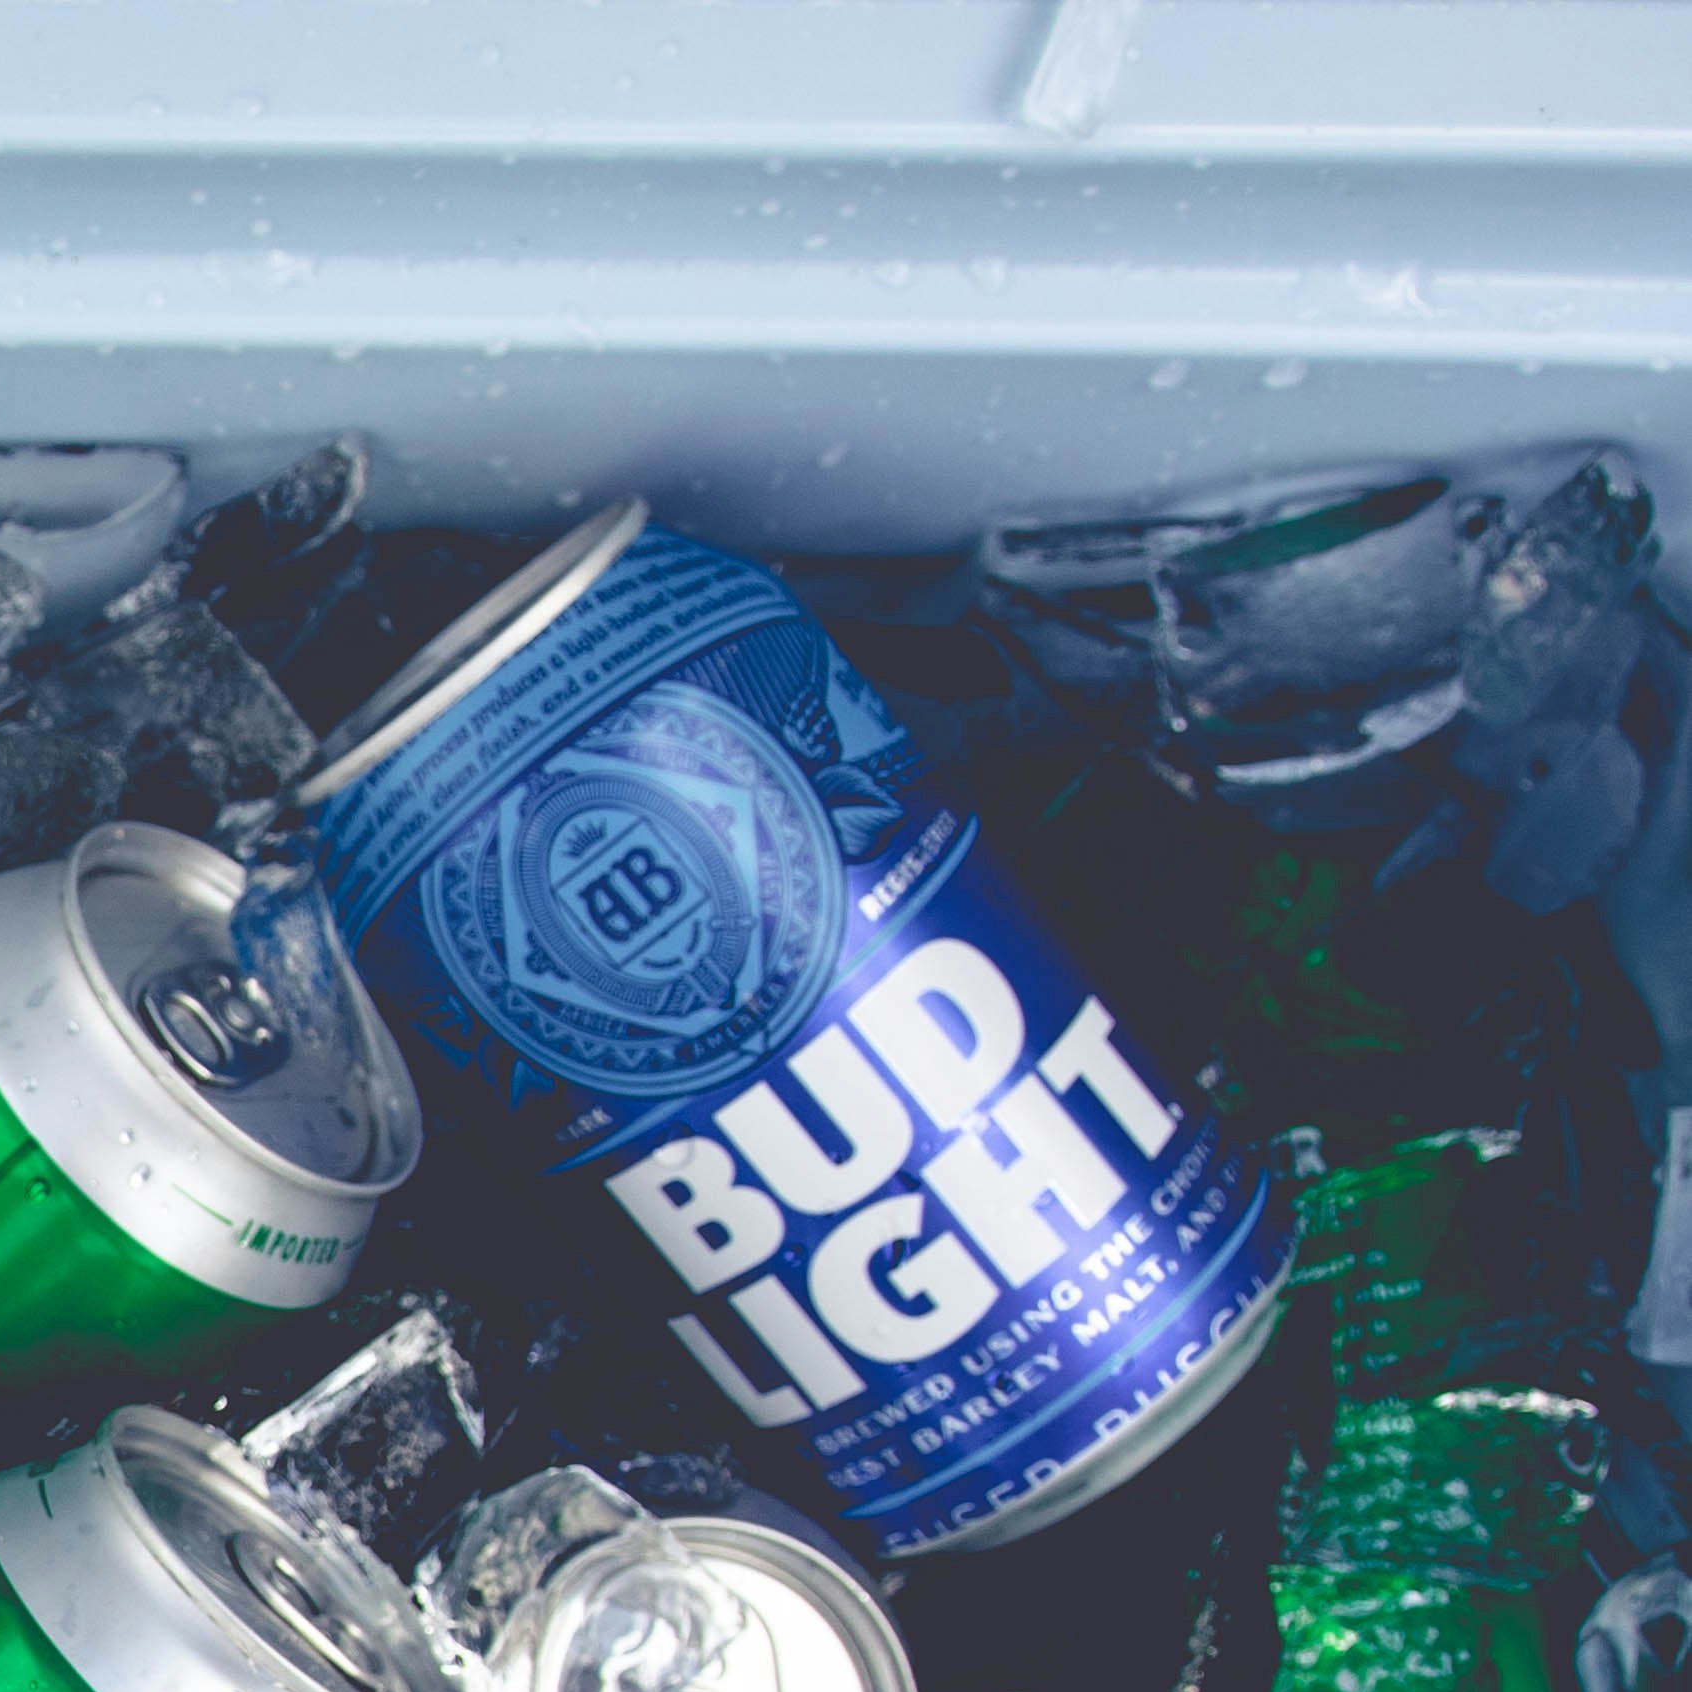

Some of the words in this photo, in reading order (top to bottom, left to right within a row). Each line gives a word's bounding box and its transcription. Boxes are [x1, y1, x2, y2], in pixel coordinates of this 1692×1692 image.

[239, 1217, 341, 1265] IMPORTED
[603, 936, 1026, 1295] BUD
[667, 995, 1177, 1430] LIGHT
[814, 1372, 956, 1457] BREWED
[961, 1279, 1084, 1377] USING
[1078, 1213, 1154, 1280] THE
[911, 1344, 1063, 1455] BARLEY
[1070, 1253, 1179, 1348] MALT,
[1175, 1186, 1227, 1254] AND
